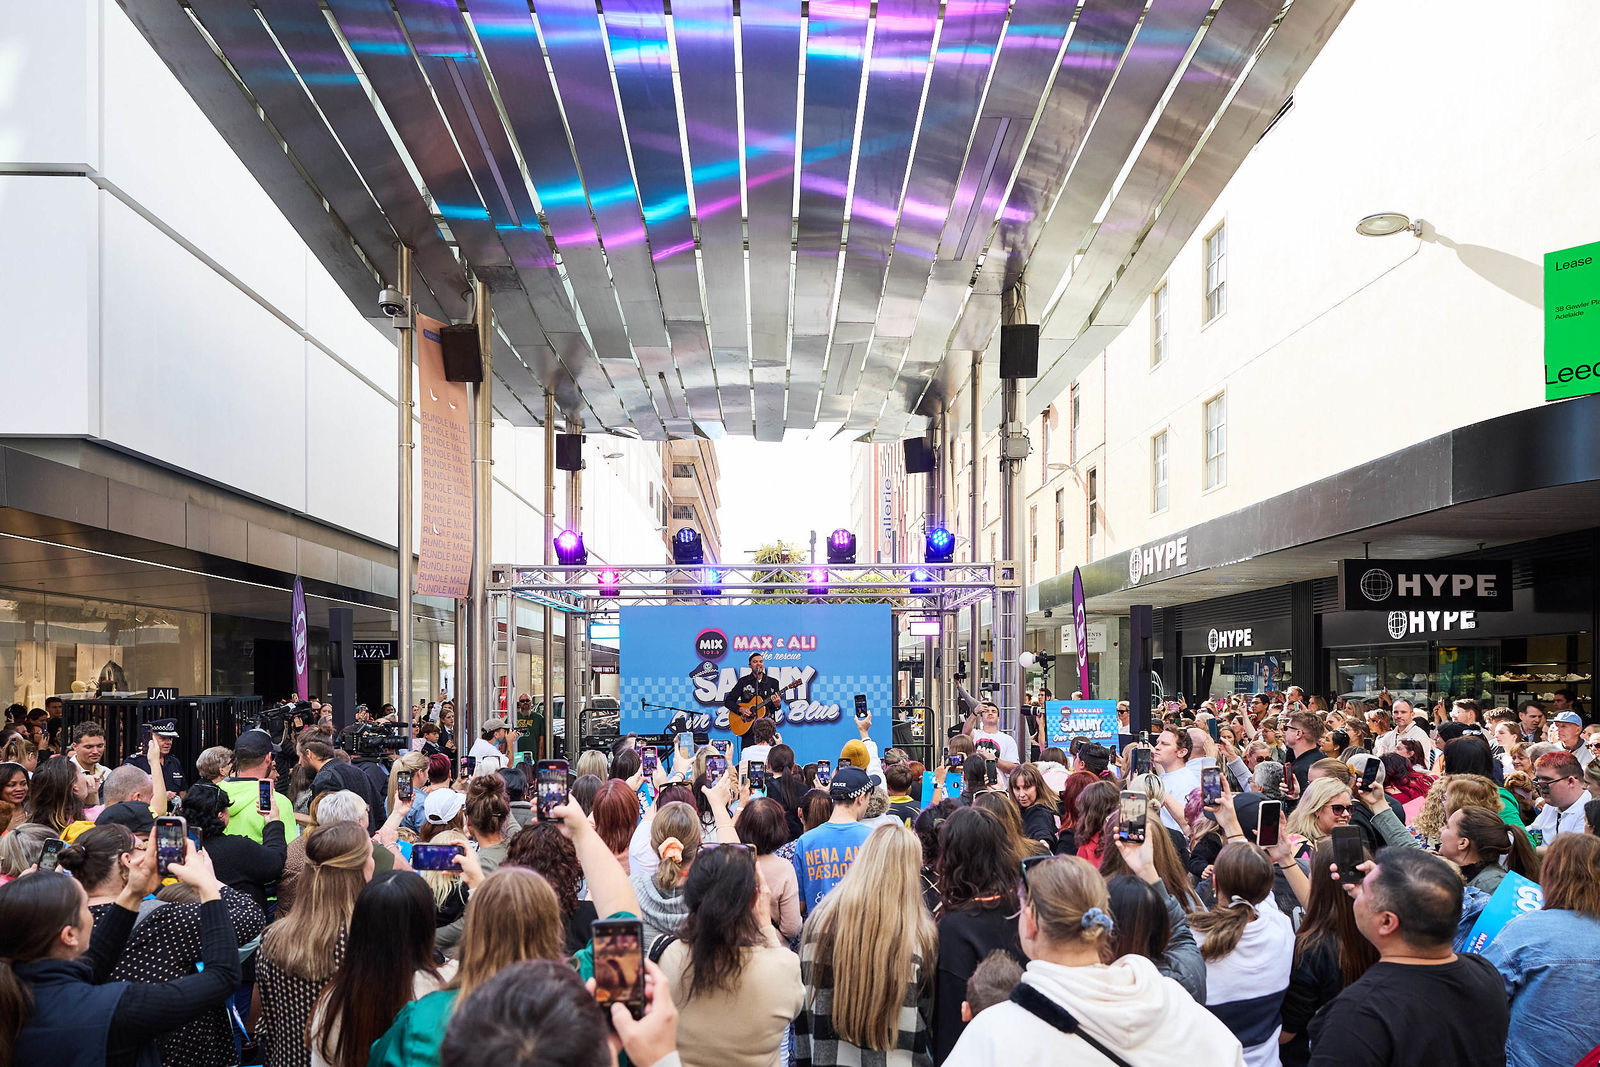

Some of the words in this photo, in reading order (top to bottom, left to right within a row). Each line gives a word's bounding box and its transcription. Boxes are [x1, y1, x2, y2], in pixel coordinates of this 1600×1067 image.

[1555, 256, 1593, 272] Lease
[1565, 302, 1589, 311] Gawler
[1554, 310, 1584, 320] Adelaide
[883, 478, 892, 556] Gallerie
[1143, 536, 1188, 576] HYPE
[1398, 574, 1496, 596] HYPE
[1409, 610, 1475, 634] HYPE
[700, 640, 723, 650] MIX
[733, 635, 774, 650] MAX
[776, 638, 784, 648] &
[787, 635, 817, 650] ALI
[1218, 628, 1252, 648] HYPE
[353, 650, 385, 658] LAZA
[774, 652, 802, 660] rescue
[150, 689, 176, 700] JAIL
[789, 699, 840, 723] Blue
[1060, 718, 1103, 732] SAMMY
[806, 848, 839, 866] NENA
[1474, 932, 1488, 950] MAX
